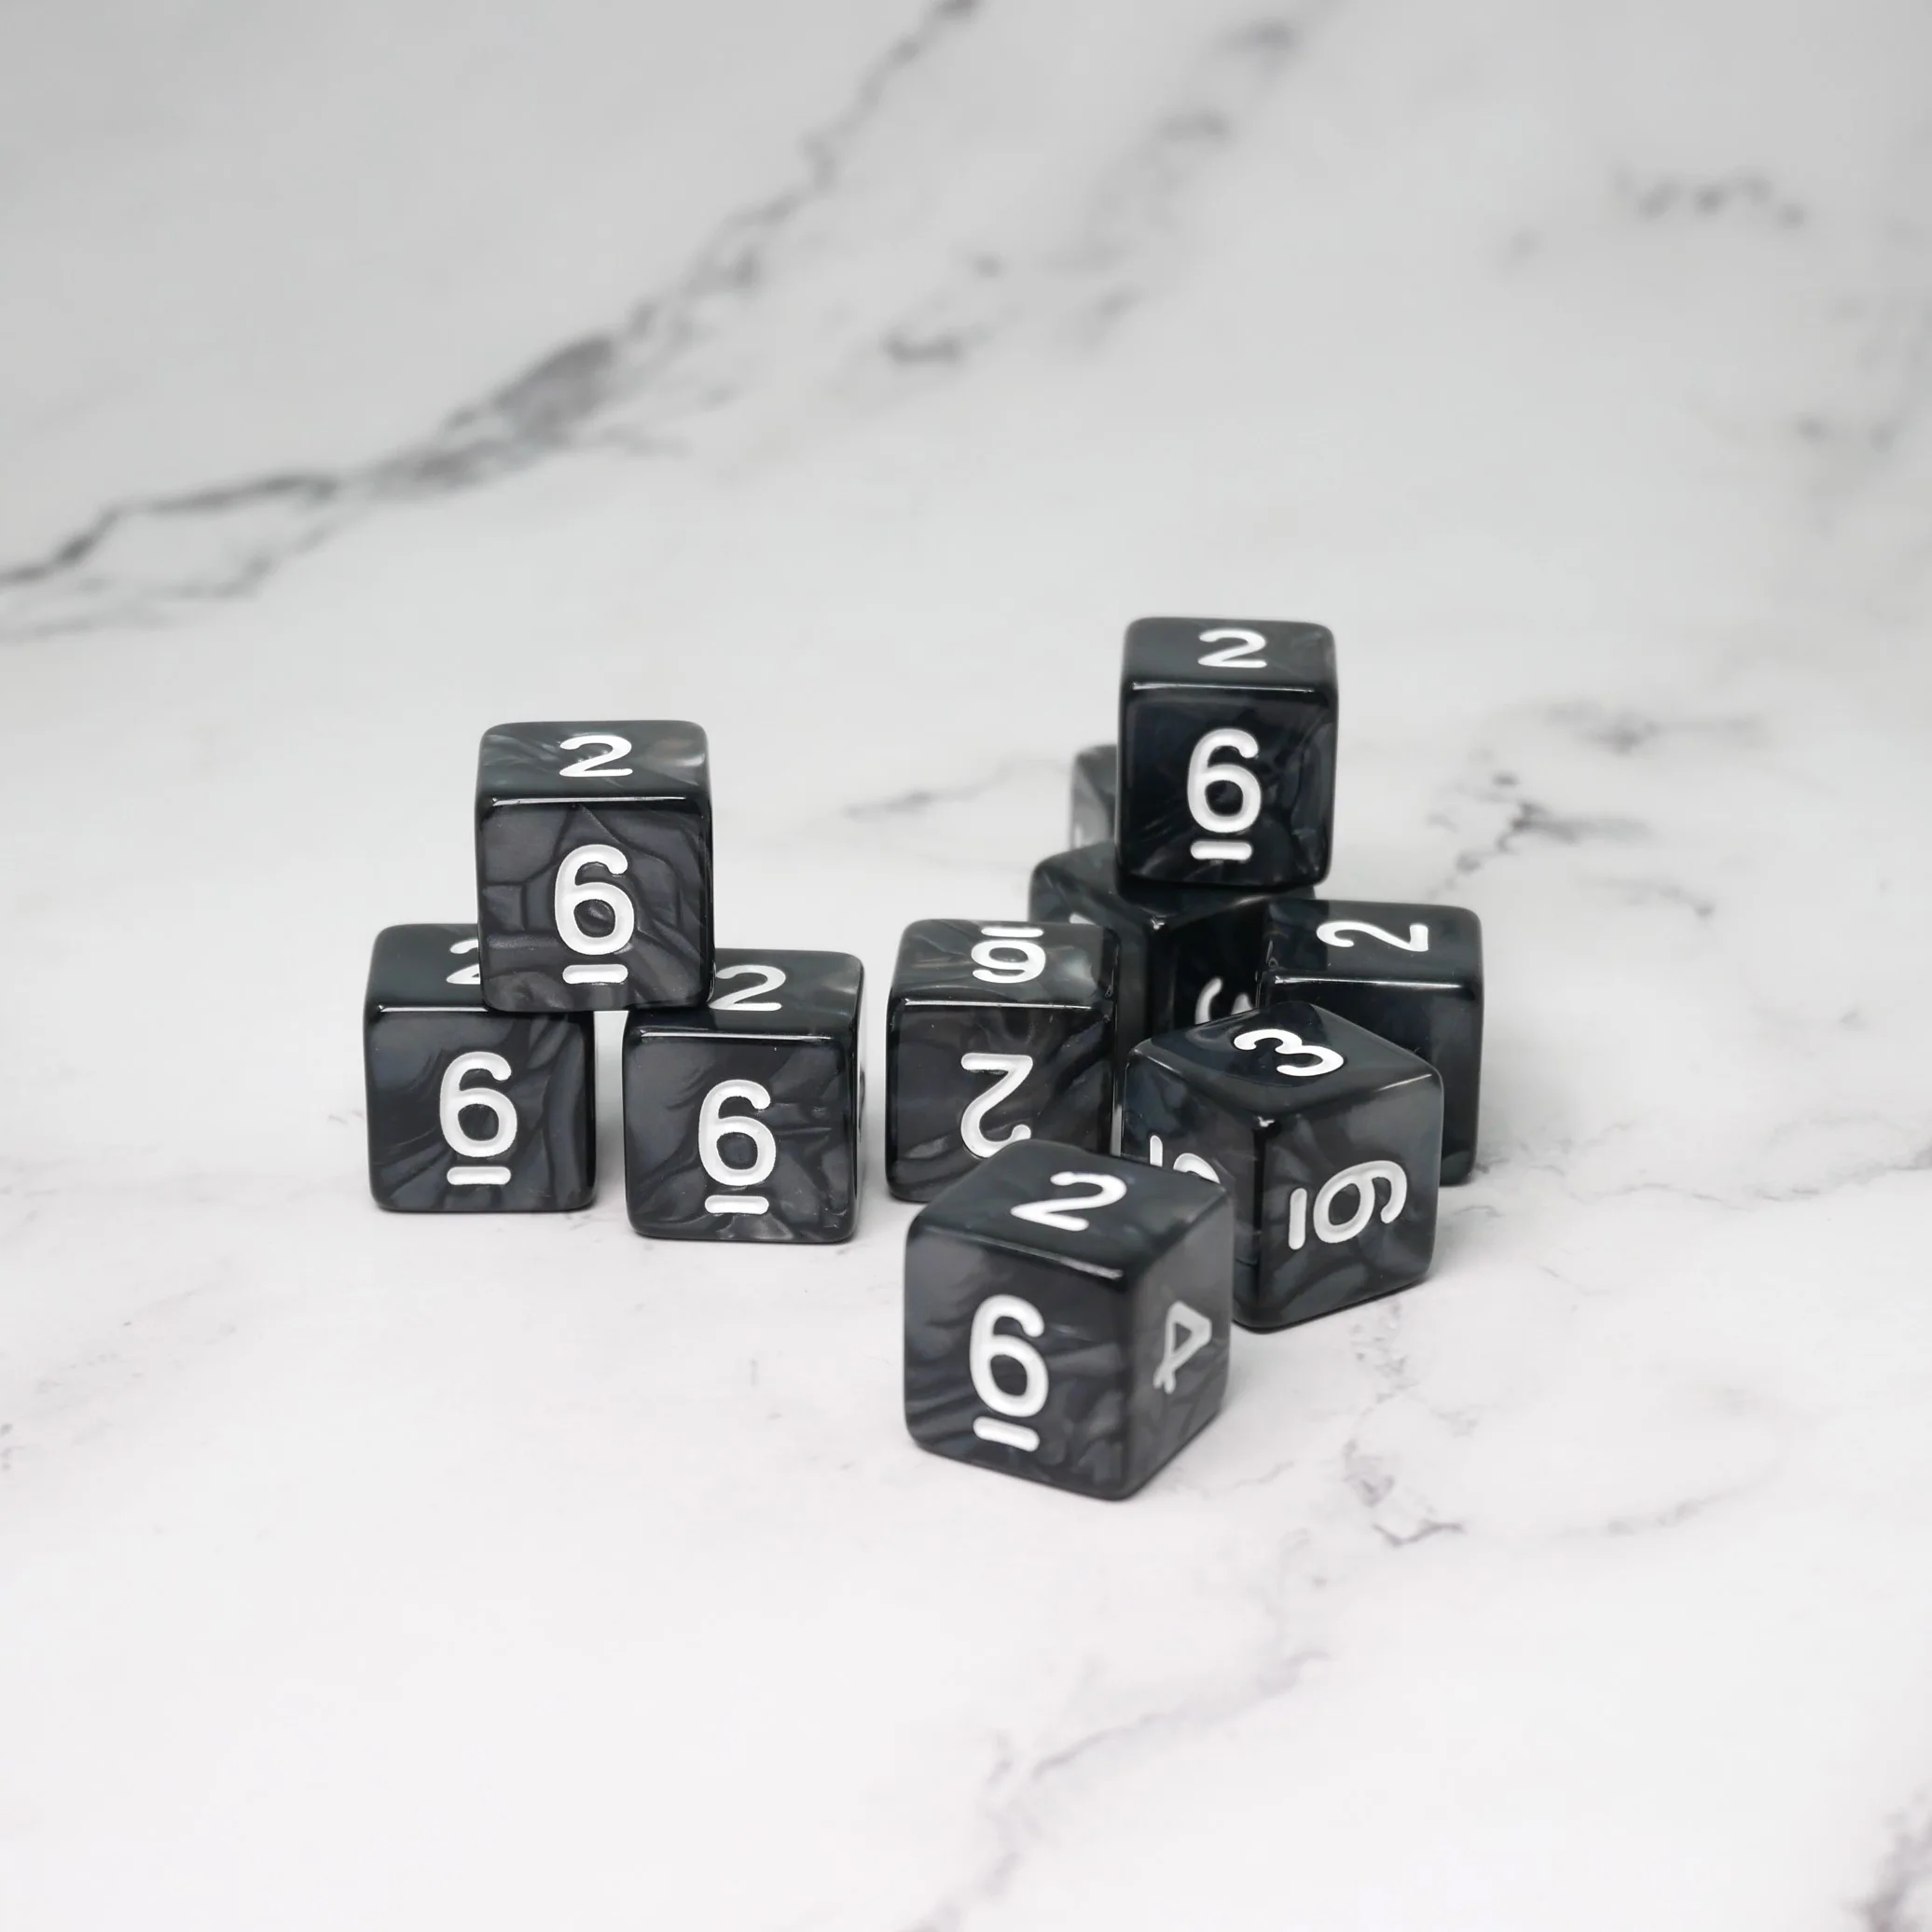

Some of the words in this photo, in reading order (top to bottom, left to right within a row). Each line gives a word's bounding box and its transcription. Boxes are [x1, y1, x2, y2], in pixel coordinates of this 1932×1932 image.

[1197, 628, 1268, 669] 2
[559, 732, 634, 779] 2
[1186, 727, 1262, 862] 6
[554, 843, 635, 985] 6
[969, 924, 1047, 984] 6
[1316, 919, 1429, 952] 2
[708, 963, 787, 1012] 2
[1233, 1028, 1345, 1077] 3
[439, 1050, 518, 1187] 6
[697, 1078, 778, 1216] 6
[959, 1051, 1034, 1159] 2
[1010, 1171, 1128, 1232] 2
[1288, 1159, 1408, 1250] 6
[969, 1293, 1049, 1453] 6
[1152, 1300, 1212, 1395] 4
